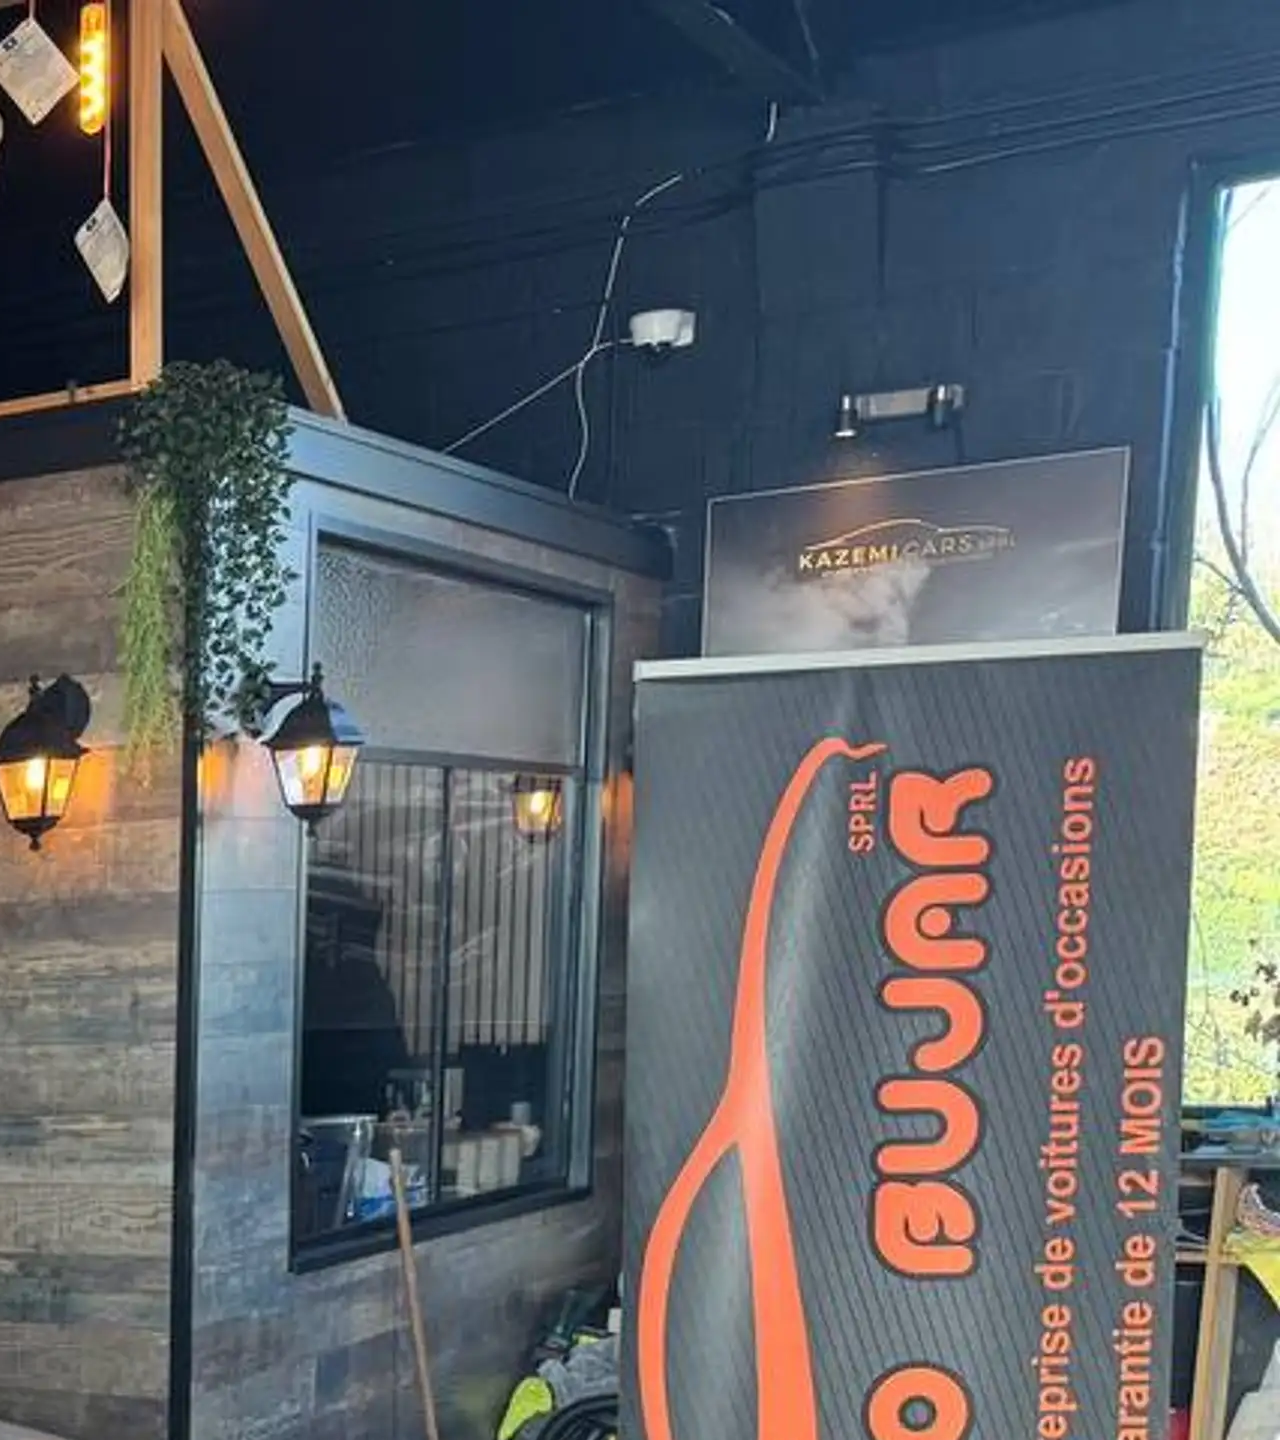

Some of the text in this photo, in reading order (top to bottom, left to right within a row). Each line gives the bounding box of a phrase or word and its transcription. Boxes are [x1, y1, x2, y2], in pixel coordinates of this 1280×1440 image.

[798, 544, 898, 571] KAZEMI
[901, 533, 972, 557] CARS
[849, 770, 877, 853] SPRL
[1045, 757, 1097, 1030] d'occasions
[872, 766, 994, 1278] BUJAR
[1039, 1044, 1084, 1223] voitures
[1120, 1037, 1166, 1156] MOIS
[1118, 1173, 1161, 1217] 12
[1035, 1237, 1077, 1290] de
[1114, 1235, 1156, 1286] de
